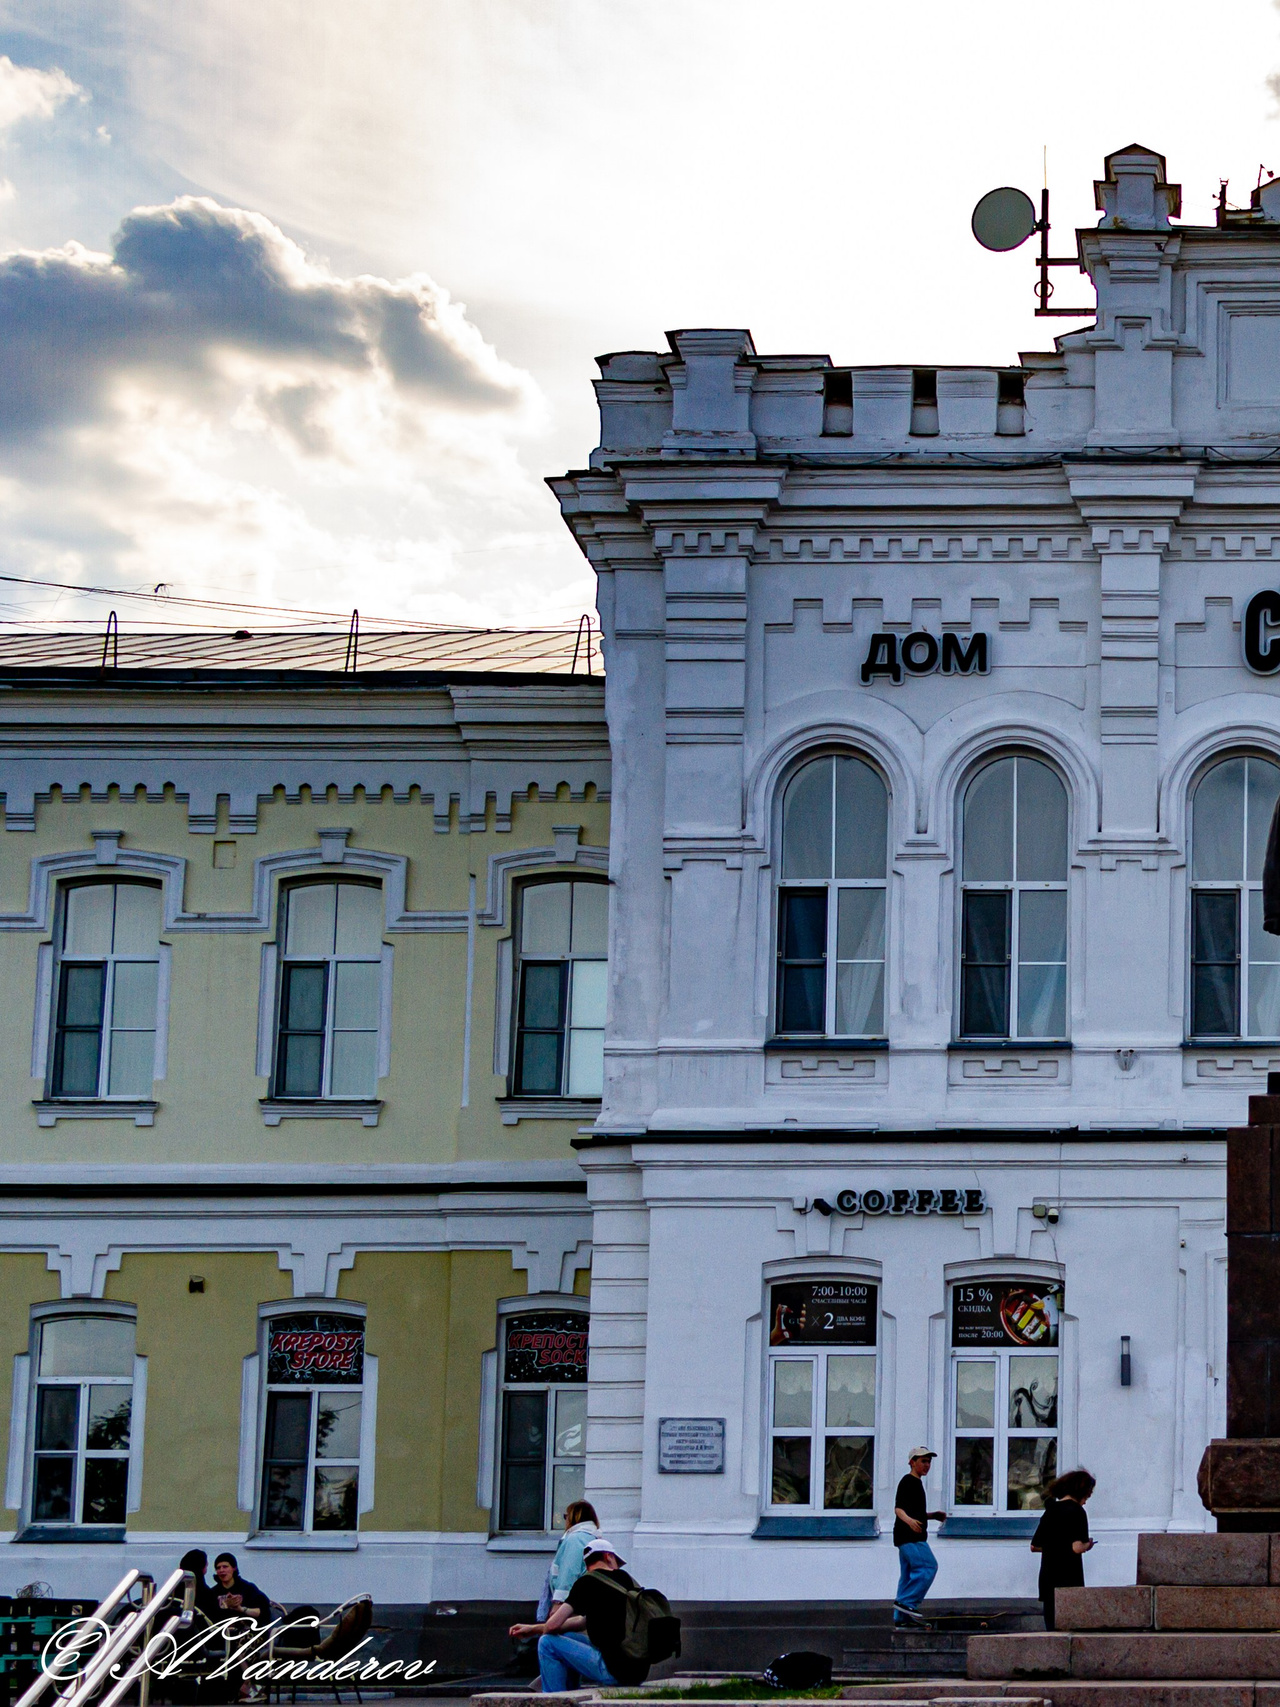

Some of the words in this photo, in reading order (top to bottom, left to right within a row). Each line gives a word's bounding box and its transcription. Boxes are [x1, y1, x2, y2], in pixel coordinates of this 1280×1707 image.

[861, 632, 987, 682] ДОМ
[837, 1189, 985, 1213] COFFEE
[812, 1286, 867, 1296] 7:00-10:00
[959, 1288, 974, 1302] 15
[958, 1304, 991, 1313] СКИДКА
[823, 1312, 835, 1329] 2
[981, 1330, 1004, 1338] 20:00
[271, 1333, 362, 1352] KREPOST
[290, 1351, 355, 1369] STORE
[539, 1349, 588, 1364] SOCK
